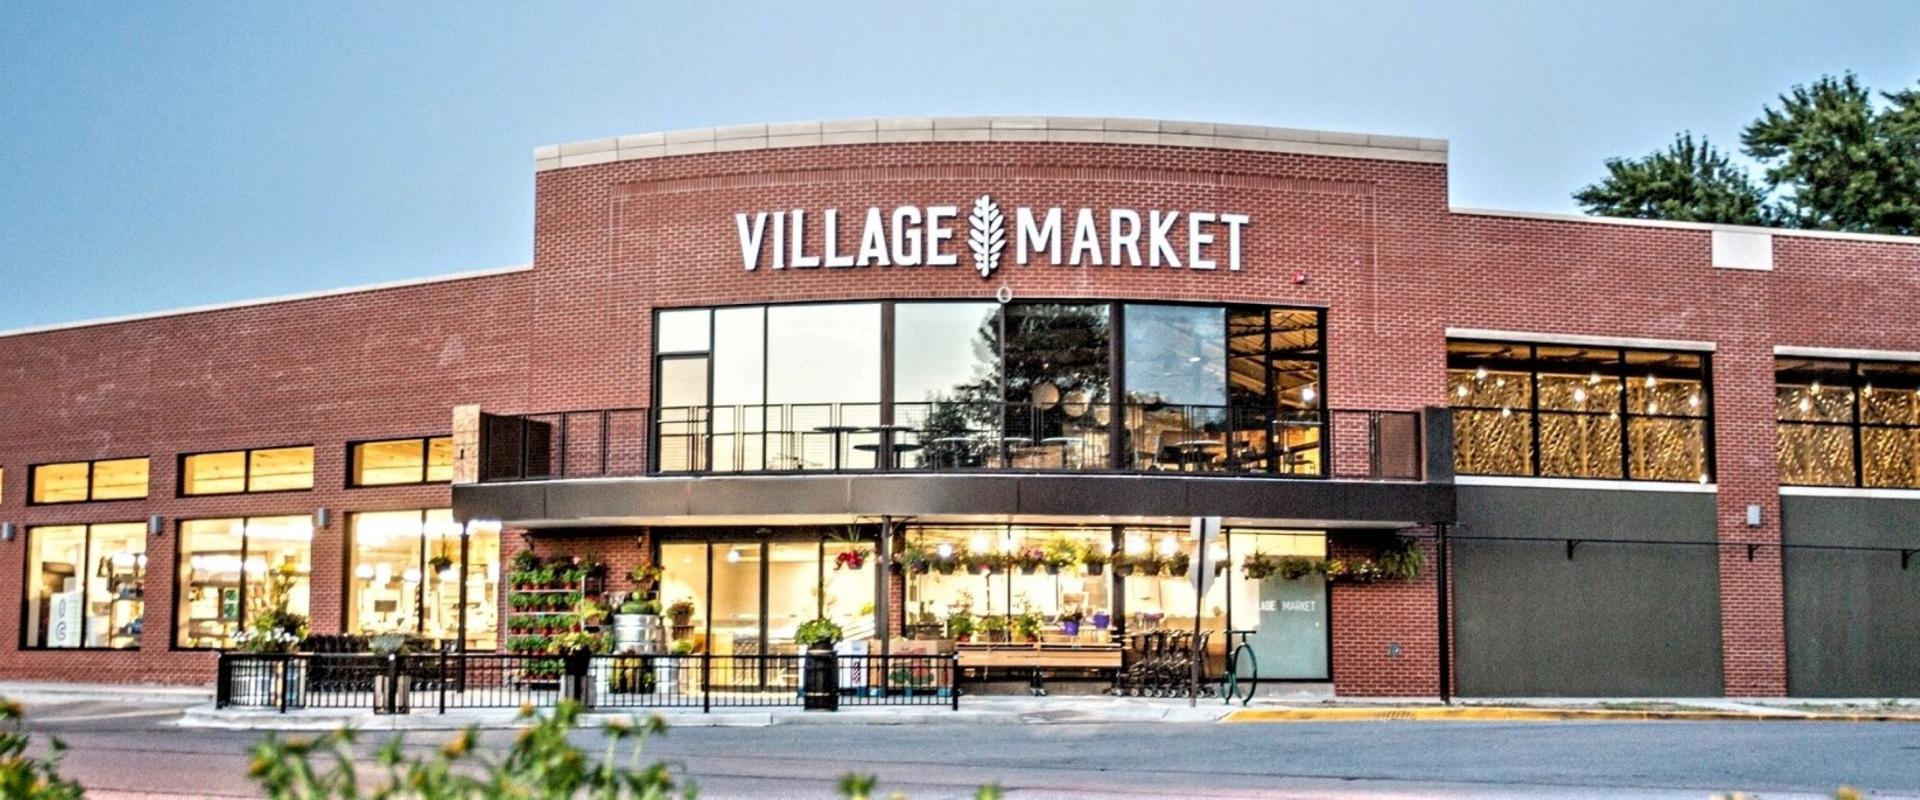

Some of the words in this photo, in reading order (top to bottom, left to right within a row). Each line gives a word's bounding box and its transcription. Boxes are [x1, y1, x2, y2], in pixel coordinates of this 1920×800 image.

[735, 205, 957, 270] VILLAGE
[1016, 207, 1249, 271] MARKET
[1281, 600, 1316, 612] MARKET
